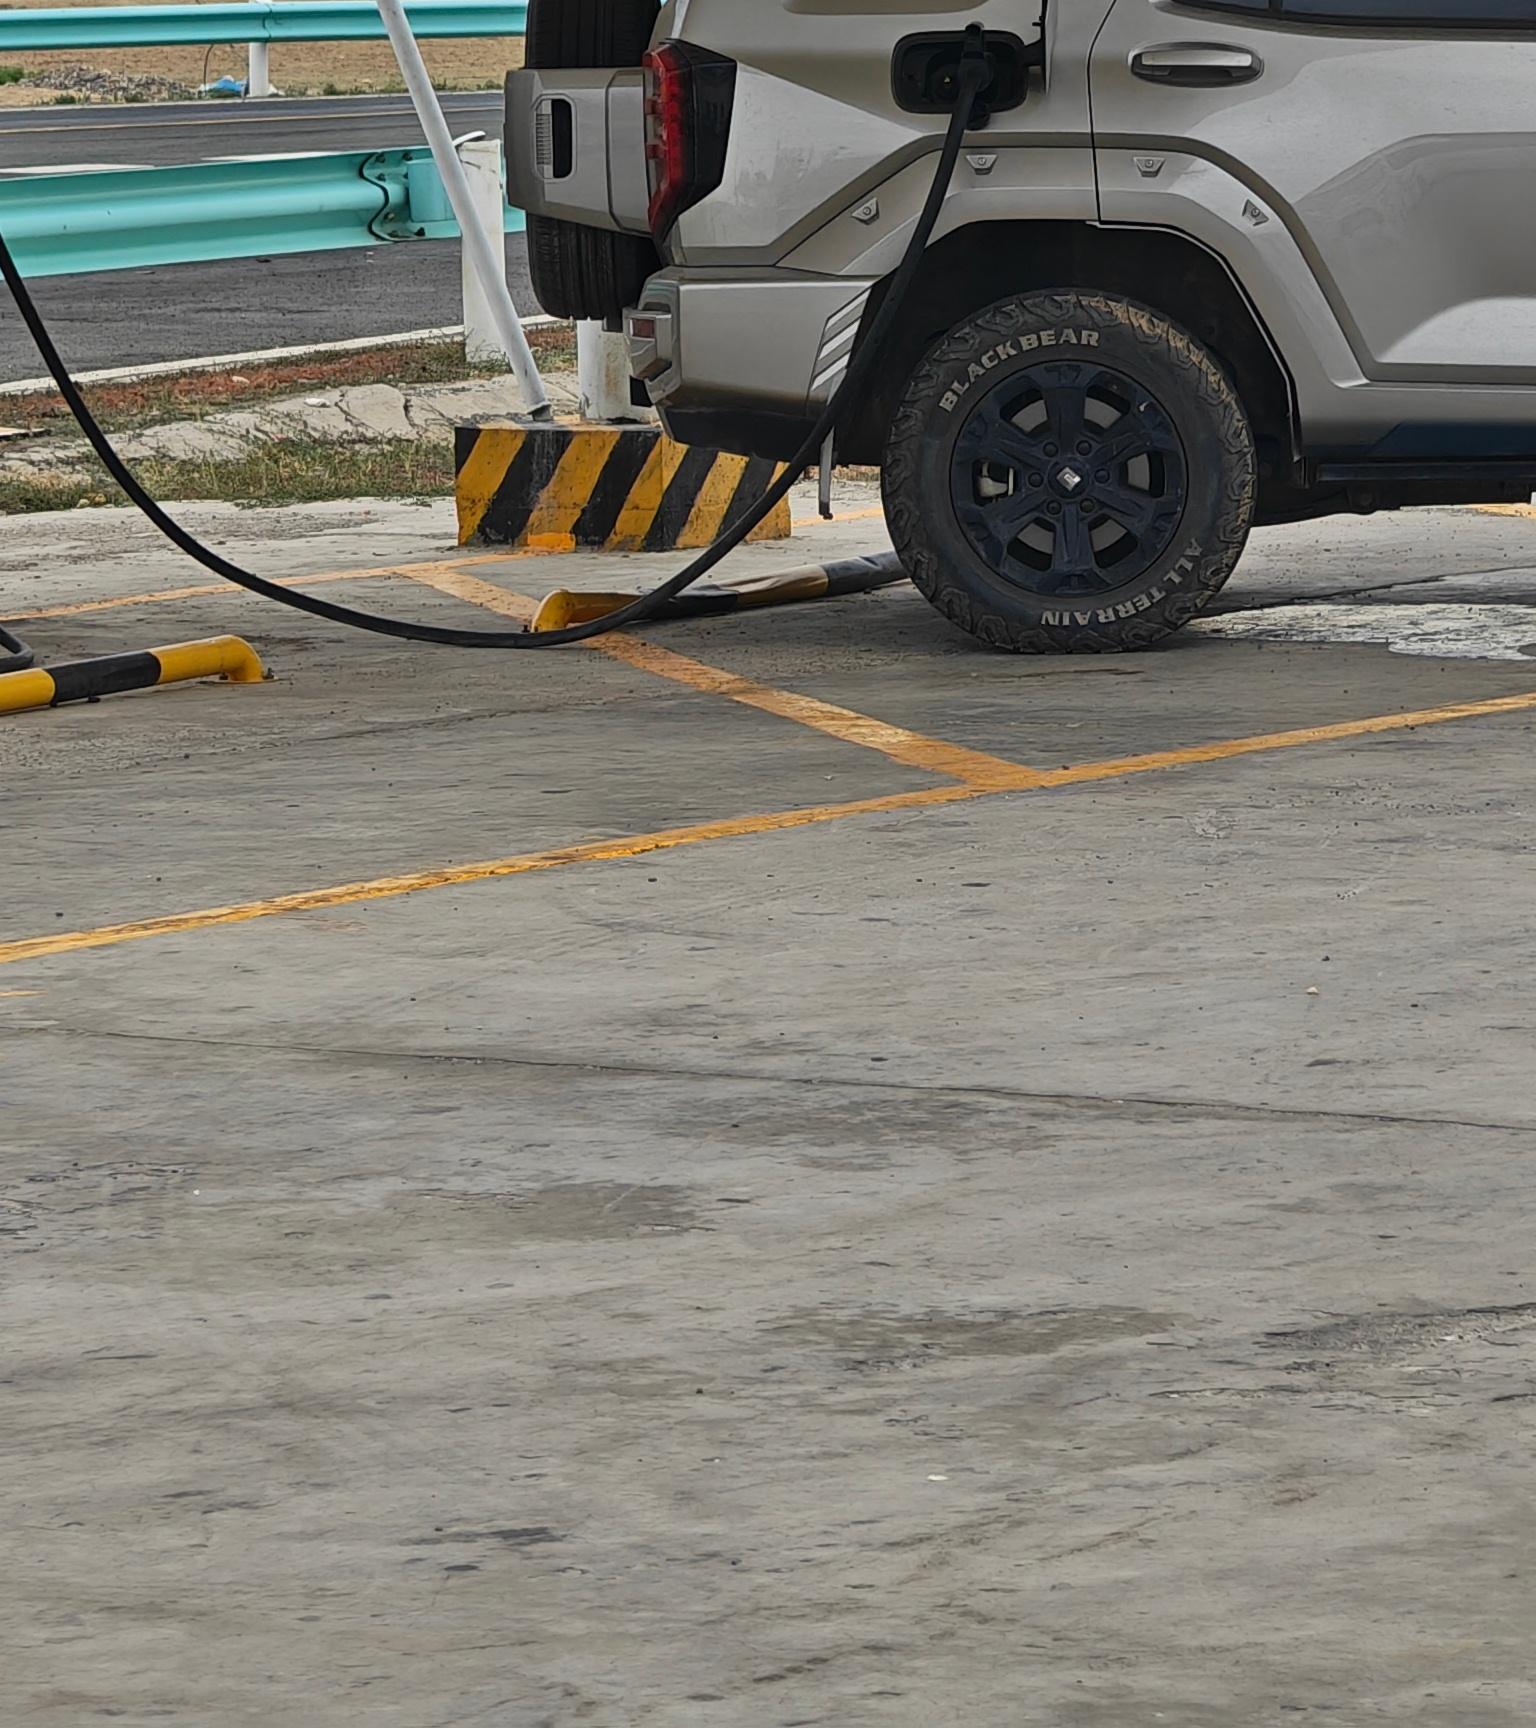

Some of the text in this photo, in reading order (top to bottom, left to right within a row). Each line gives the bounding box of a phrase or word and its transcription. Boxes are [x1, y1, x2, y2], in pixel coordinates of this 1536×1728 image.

[938, 328, 1101, 413] BLACK BEAR
[1040, 538, 1202, 627] ALL TERRAIN
